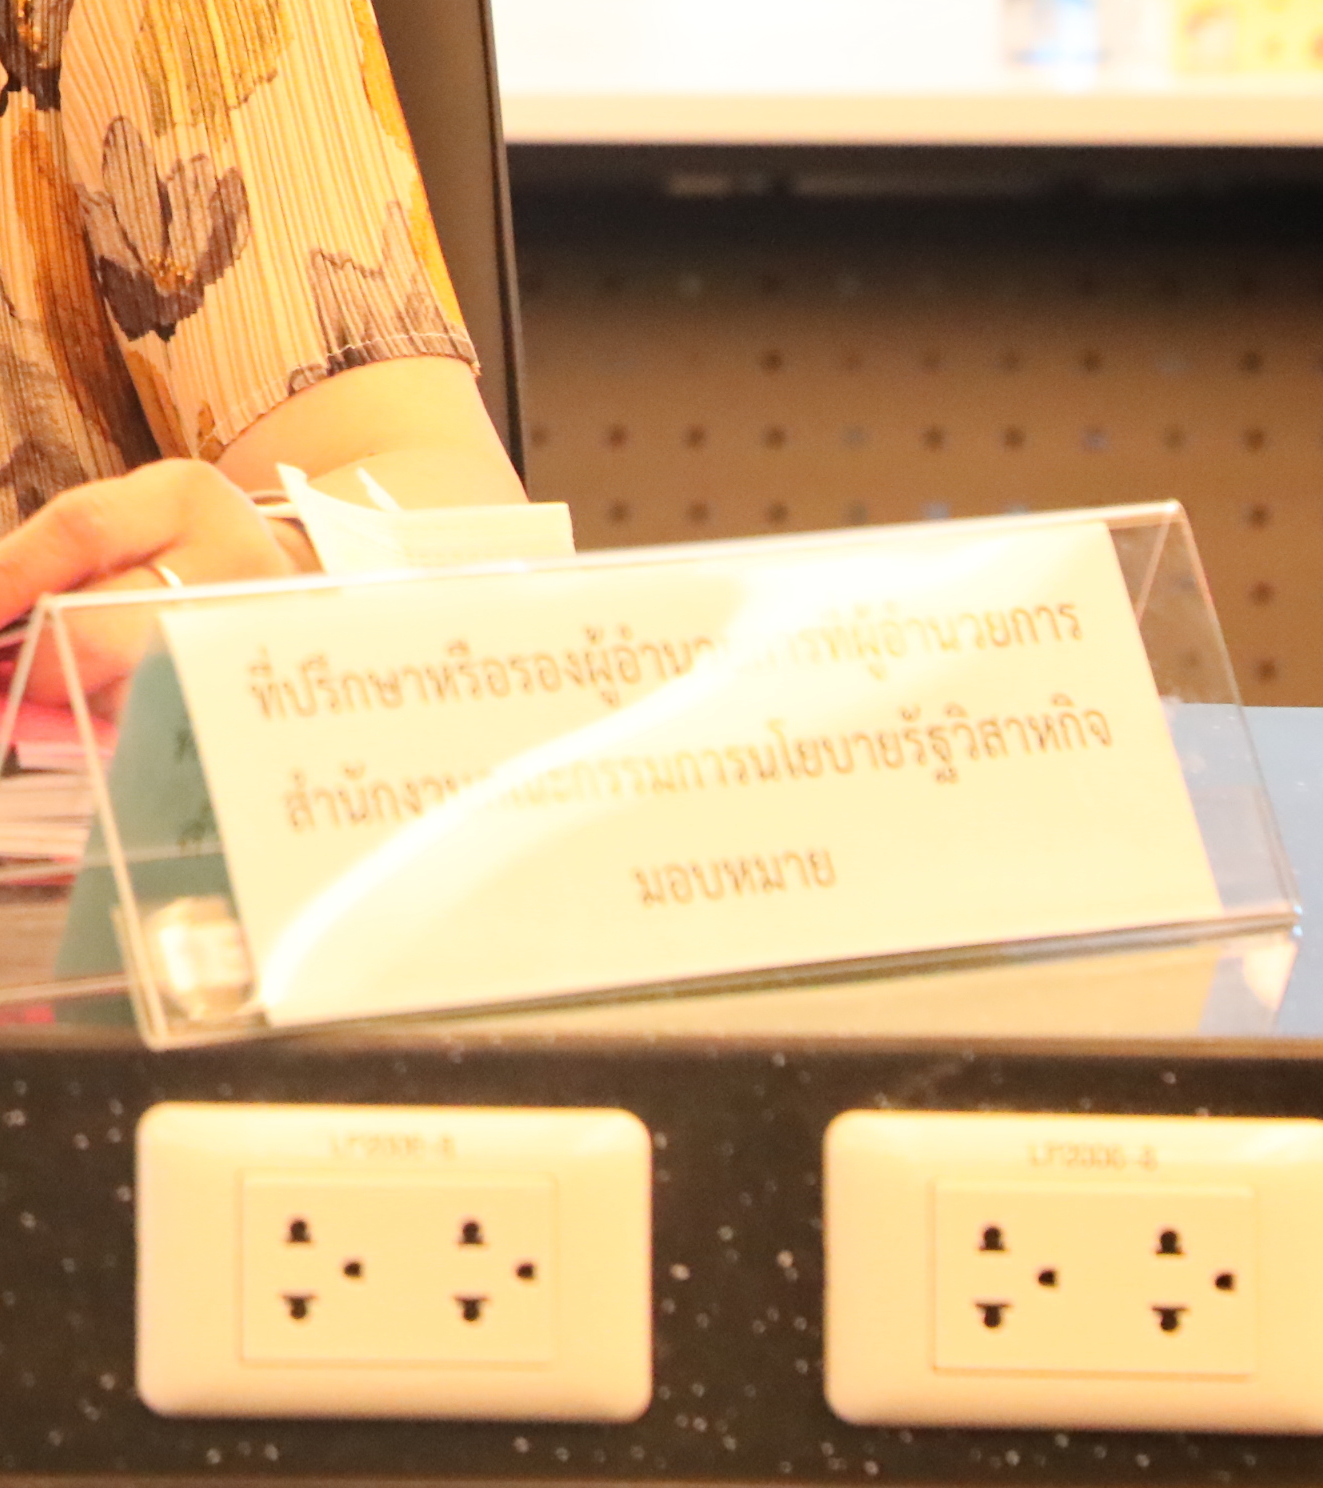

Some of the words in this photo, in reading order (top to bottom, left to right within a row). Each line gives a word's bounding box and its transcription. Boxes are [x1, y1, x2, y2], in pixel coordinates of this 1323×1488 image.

[283, 695, 1114, 834] สำนักงาณะกรรมการนโยบายรัฐวิสาหกิจ
[632, 845, 838, 908] มอบหมาย
